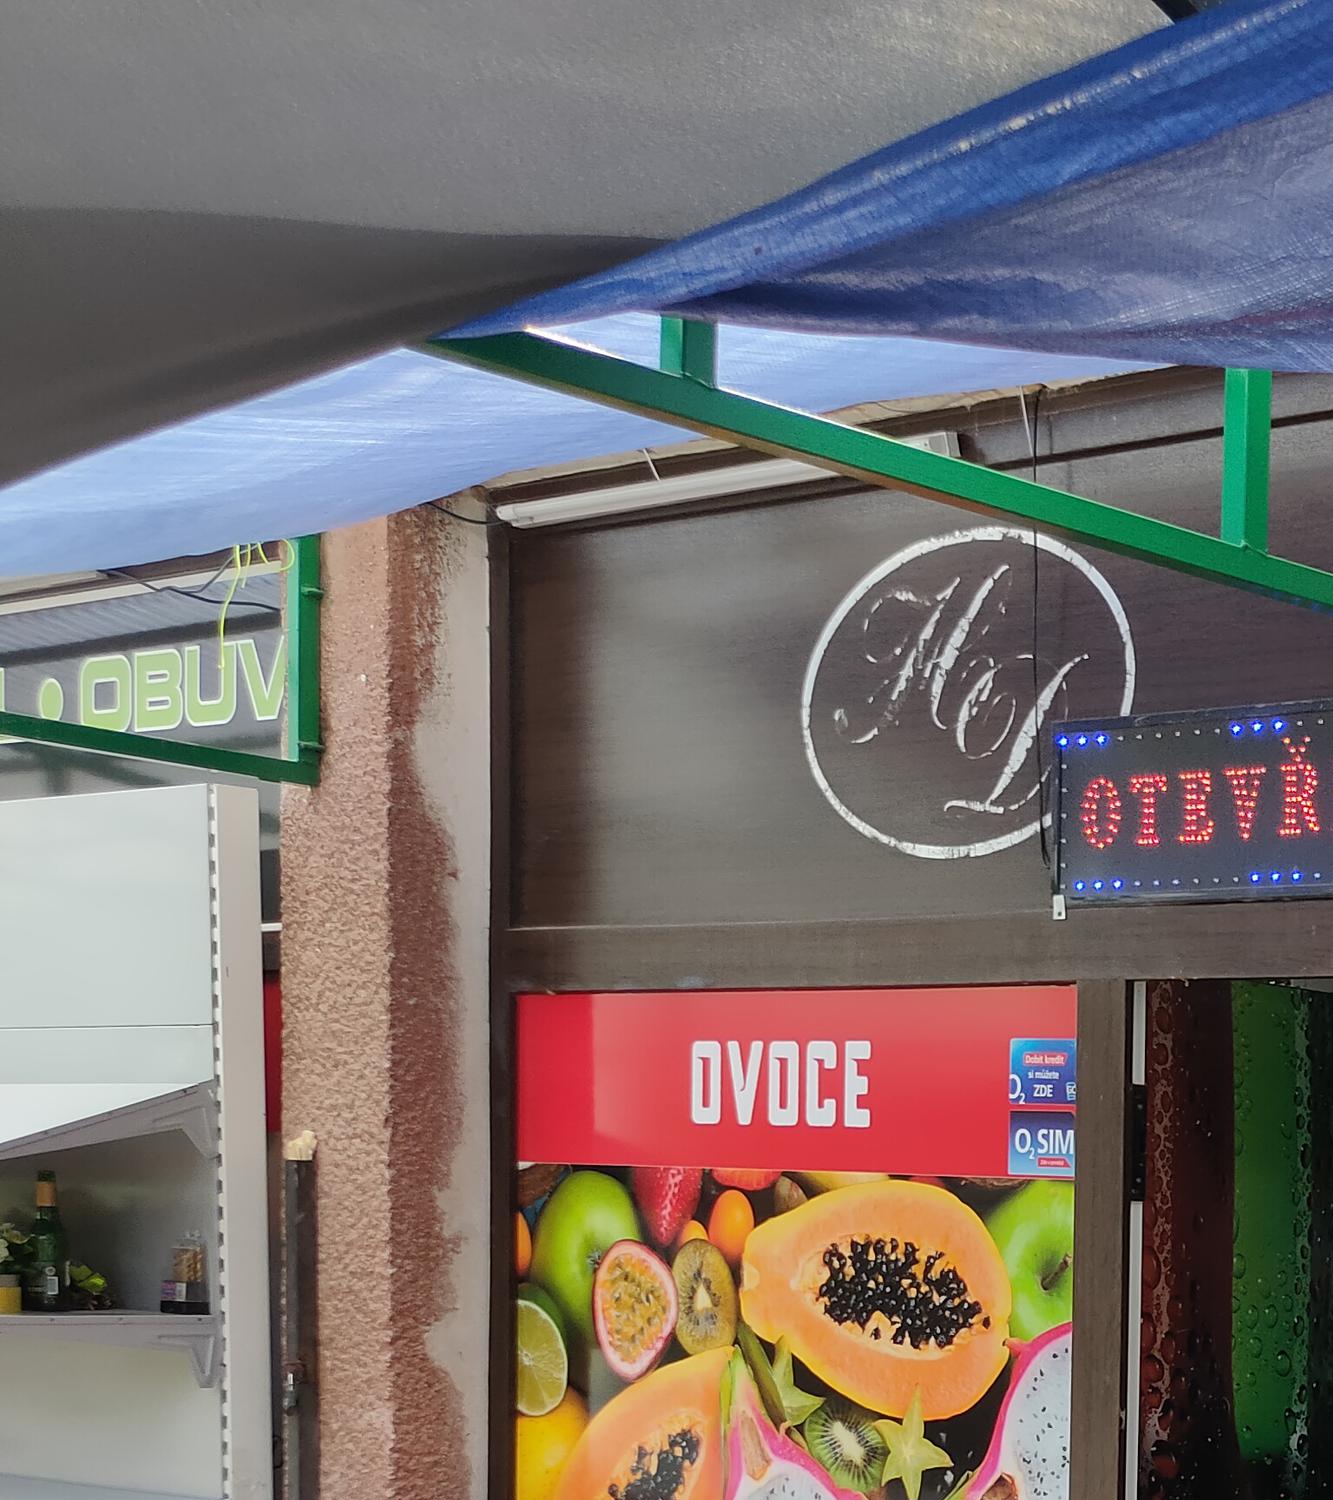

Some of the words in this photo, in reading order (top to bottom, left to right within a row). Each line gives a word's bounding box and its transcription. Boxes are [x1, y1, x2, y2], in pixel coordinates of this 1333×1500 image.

[79, 634, 285, 733] OBUV
[690, 1039, 873, 1128] OVOCE
[1033, 1084, 1053, 1098] ZDE
[1037, 1128, 1074, 1154] SIM
